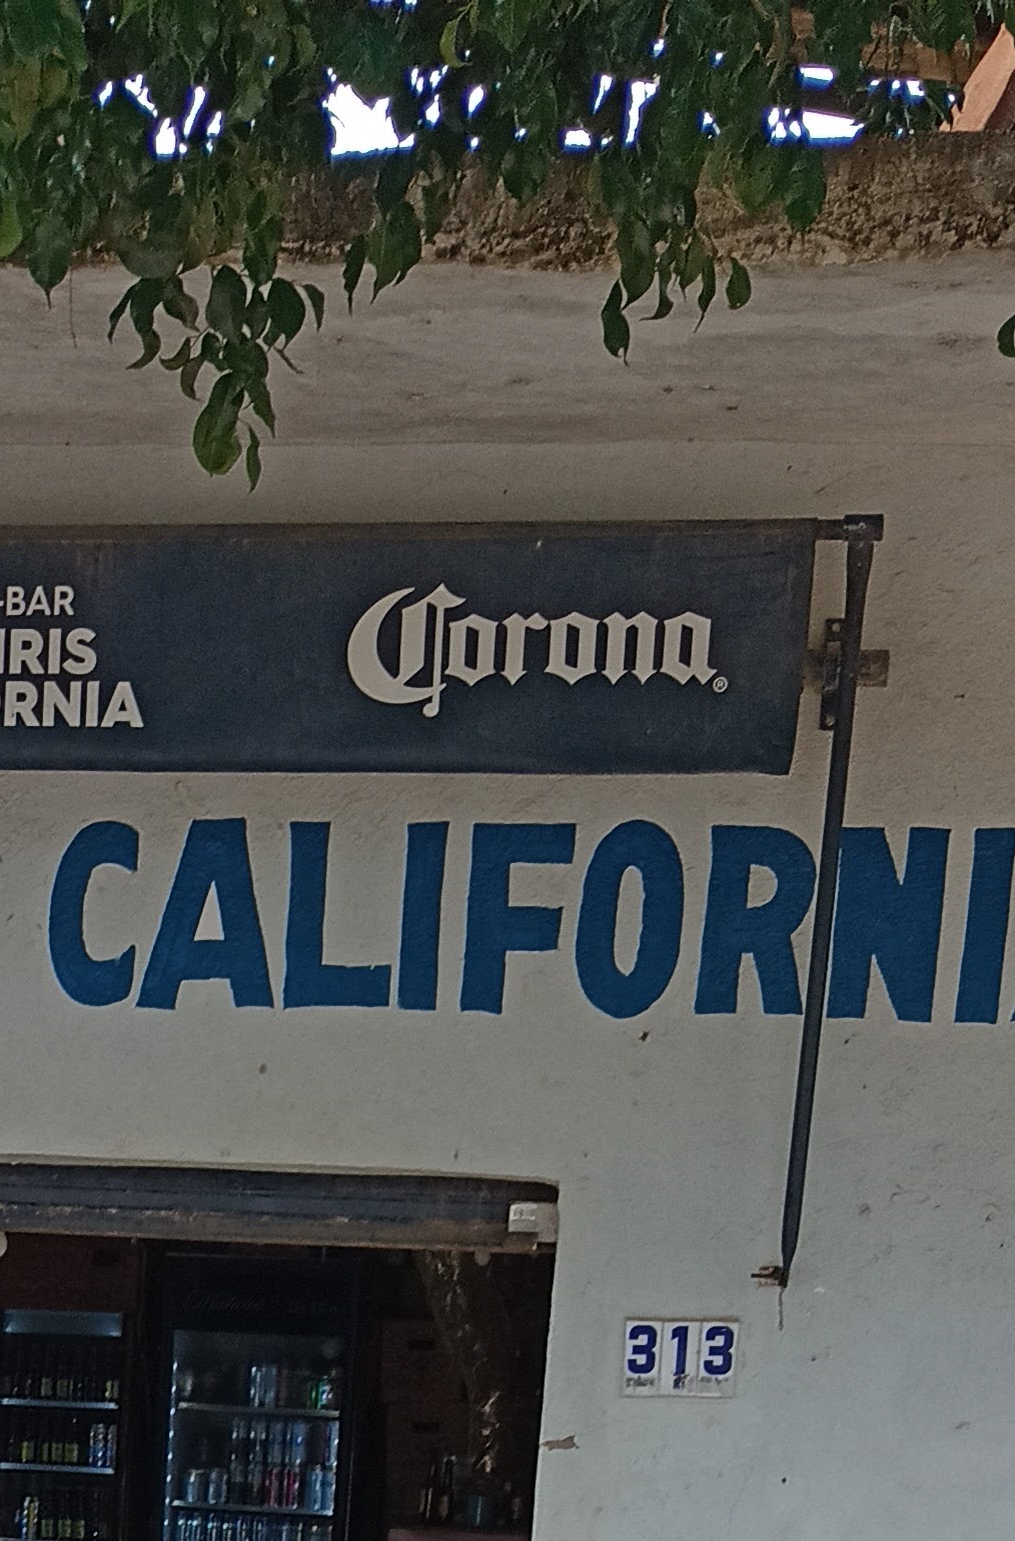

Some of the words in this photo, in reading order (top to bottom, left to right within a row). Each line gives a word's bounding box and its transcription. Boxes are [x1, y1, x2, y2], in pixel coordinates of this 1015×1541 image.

[347, 583, 718, 718] Corona
[48, 817, 1015, 1025] CALIFORNI
[627, 1324, 735, 1376] 313
